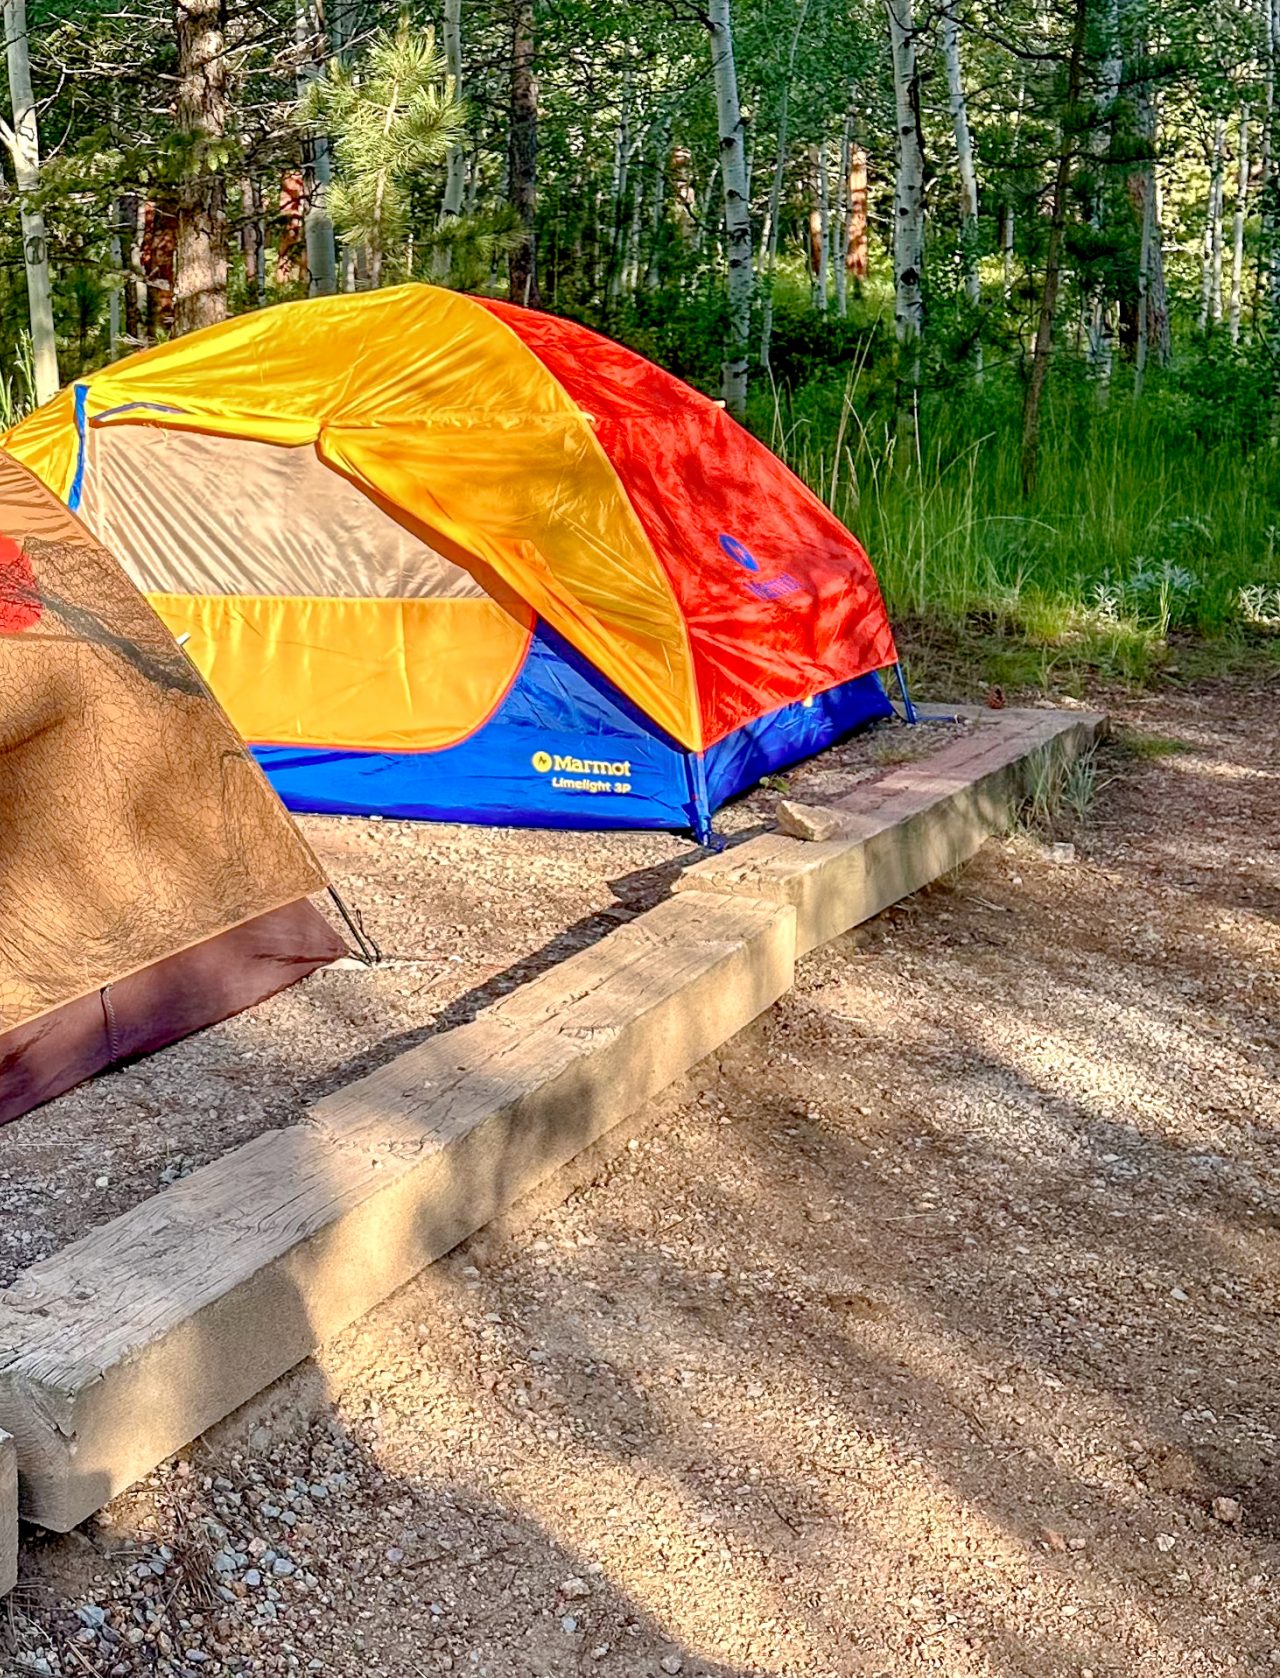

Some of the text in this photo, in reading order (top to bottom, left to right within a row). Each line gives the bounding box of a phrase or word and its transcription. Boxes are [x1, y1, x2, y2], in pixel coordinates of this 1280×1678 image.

[553, 755, 631, 776] Marmot
[552, 777, 632, 793] Limelight 3P
